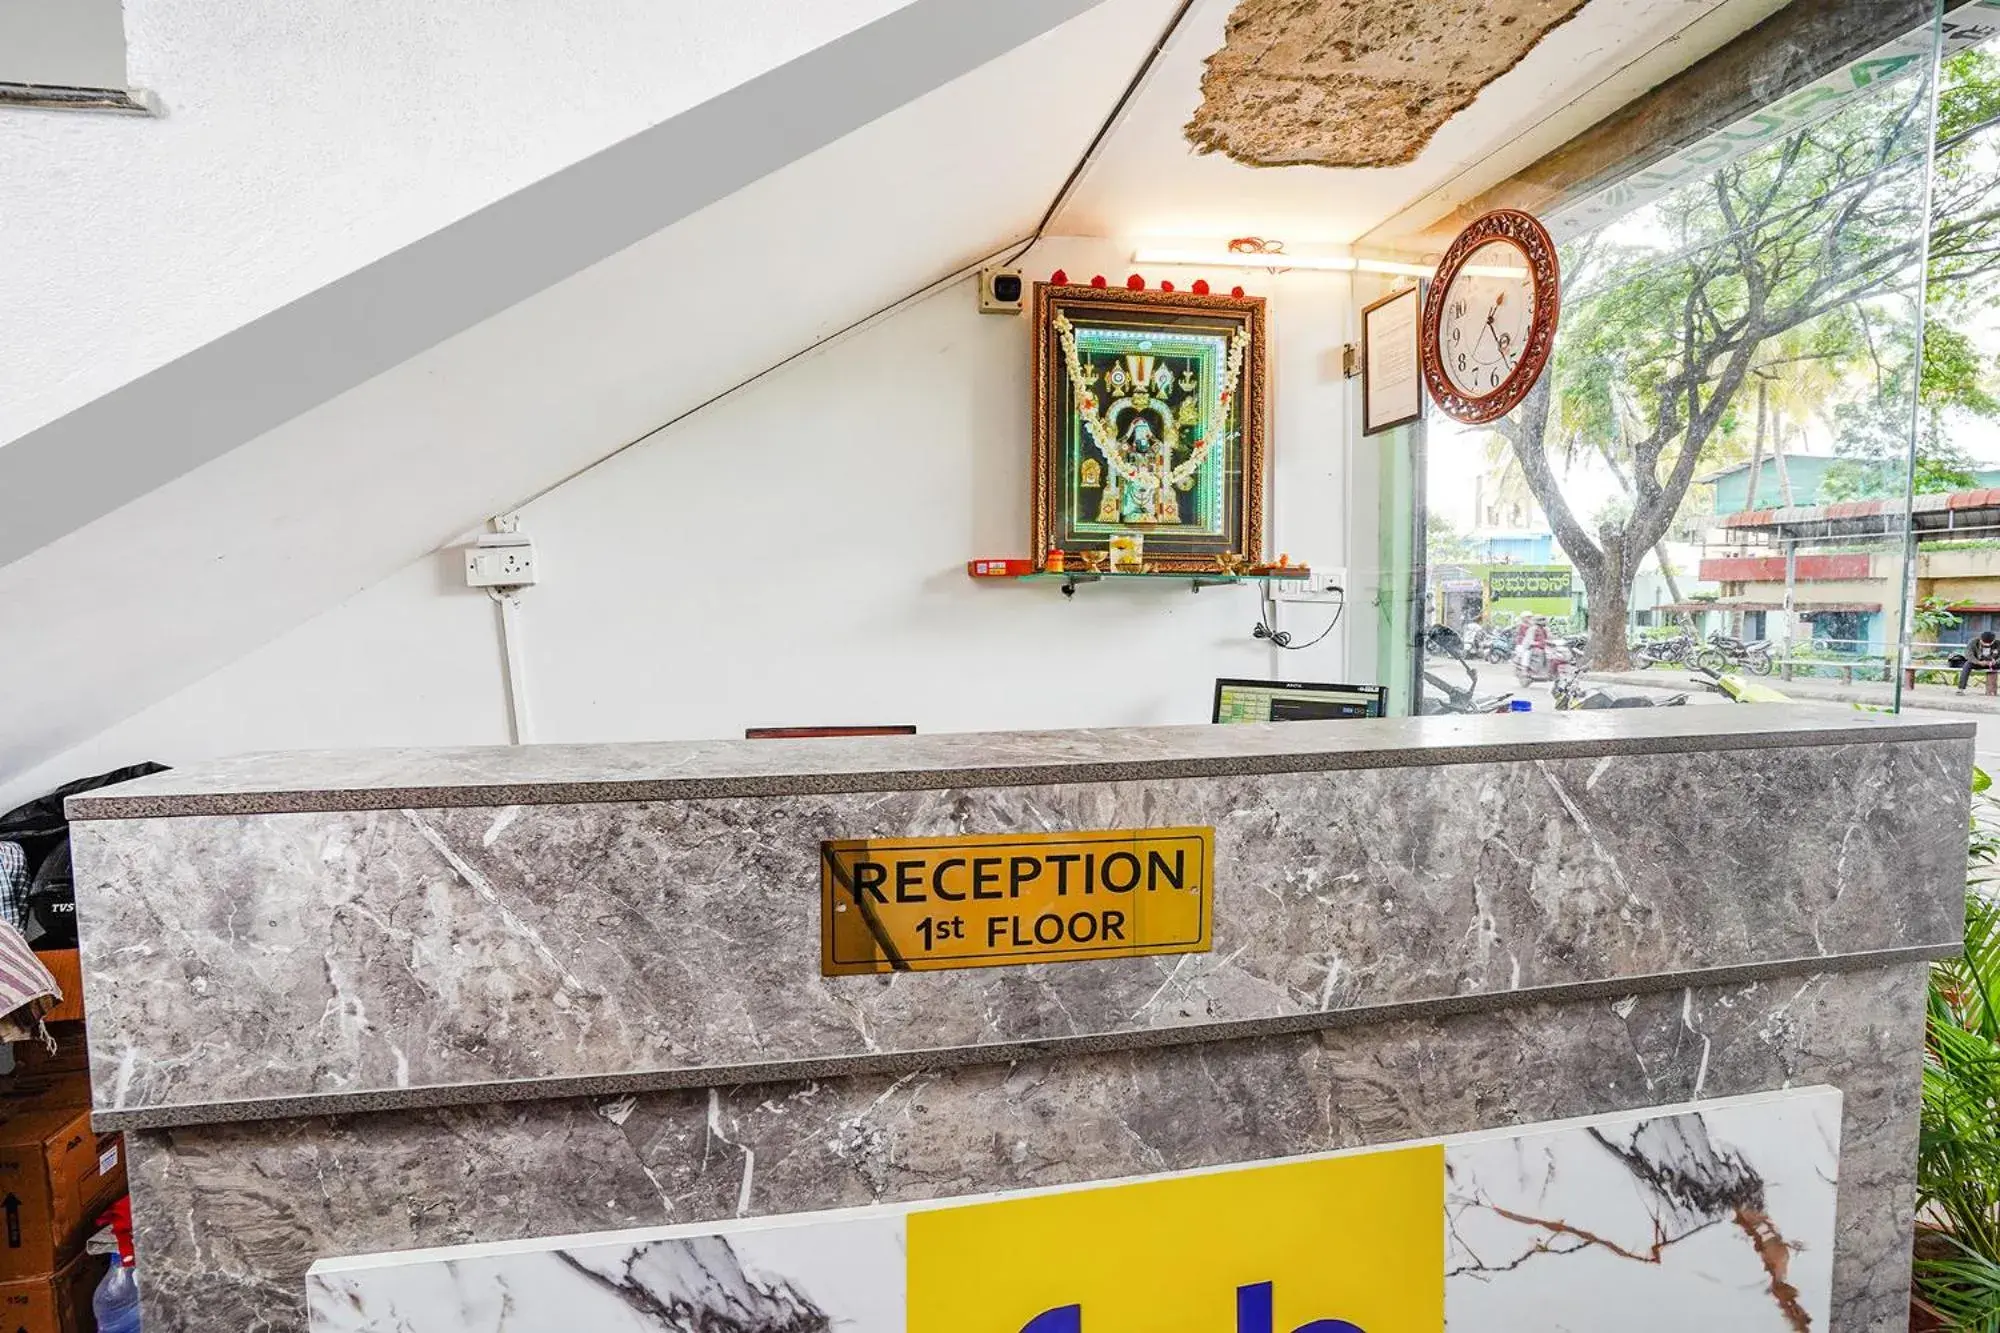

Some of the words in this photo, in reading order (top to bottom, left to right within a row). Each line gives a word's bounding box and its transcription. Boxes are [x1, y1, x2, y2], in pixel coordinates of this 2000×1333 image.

[1452, 327, 1461, 347] 9
[1458, 353, 1466, 372] 8
[1471, 367, 1479, 386] 7
[1490, 367, 1500, 387] 6
[851, 849, 1185, 906] RECEPTION
[51, 903, 75, 913] TVS
[915, 915, 965, 951] 1st
[987, 910, 1126, 948] FLOOR
